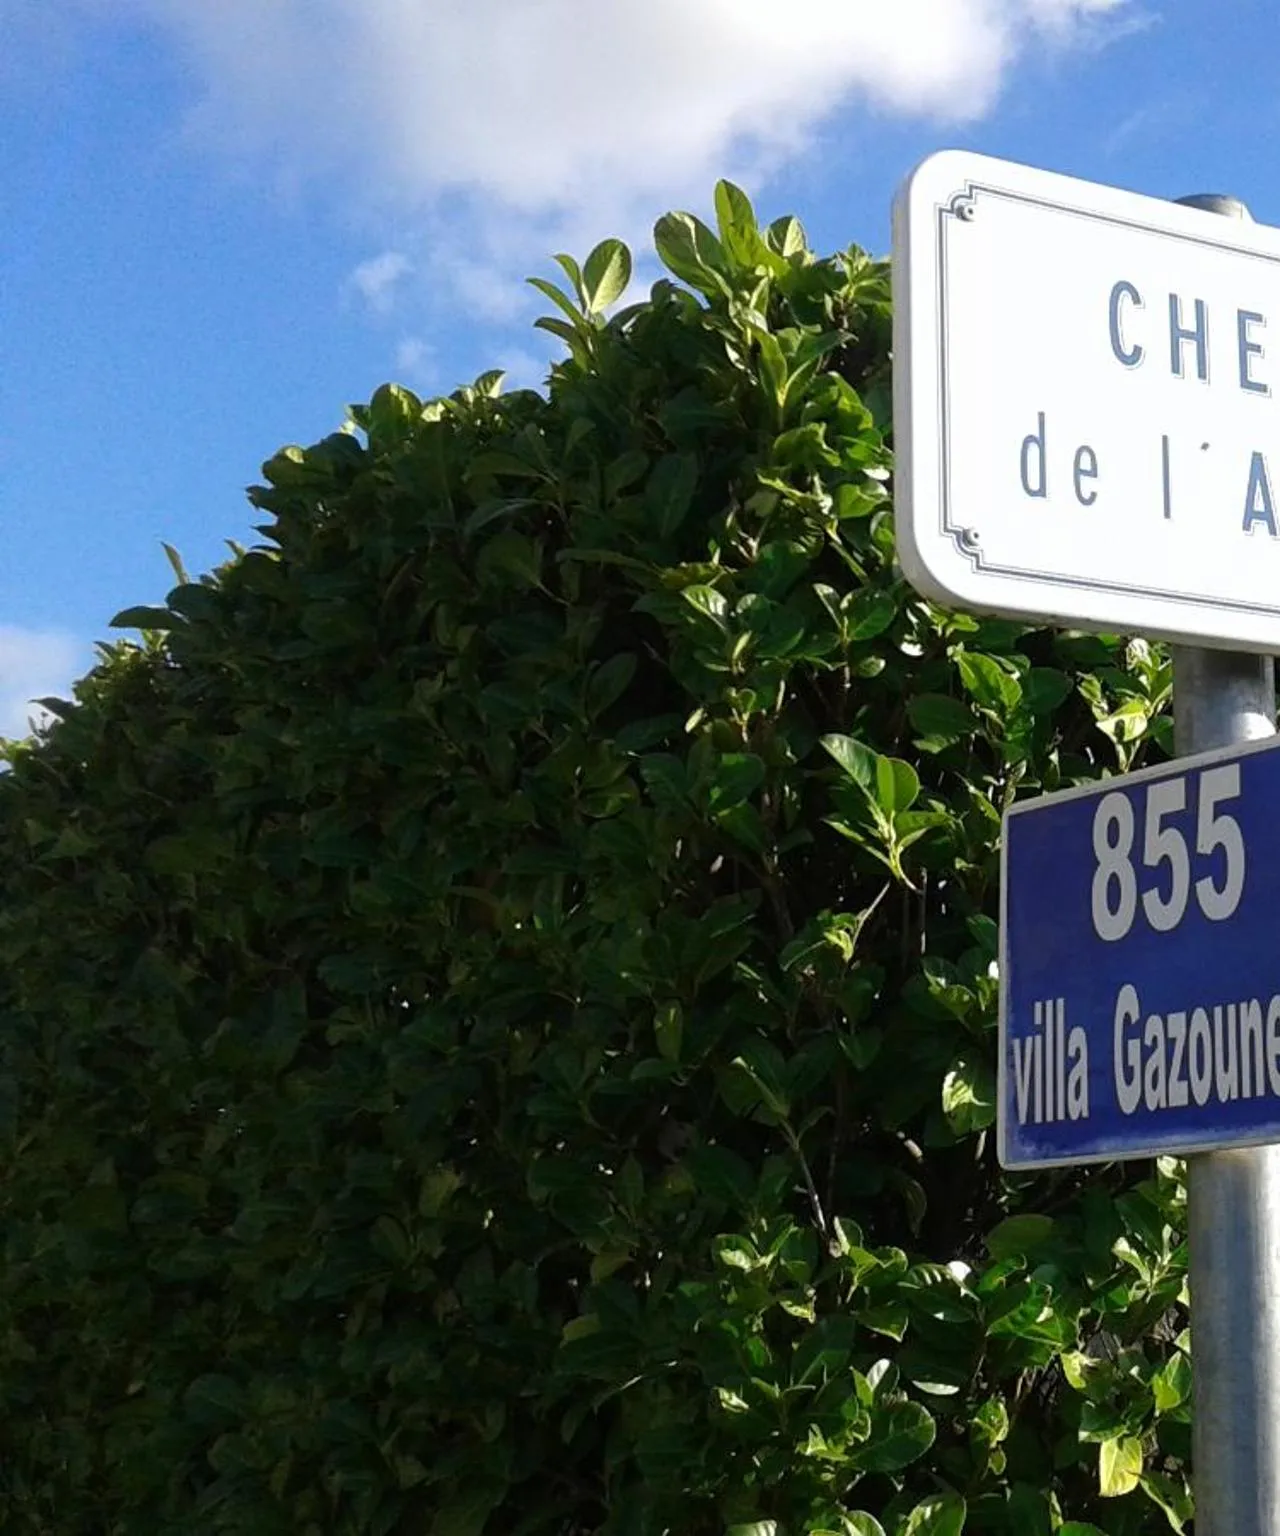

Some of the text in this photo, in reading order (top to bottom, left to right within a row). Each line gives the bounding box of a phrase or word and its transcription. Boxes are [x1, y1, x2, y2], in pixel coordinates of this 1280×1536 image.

[1019, 411, 1100, 507] de
[1091, 763, 1246, 942] 855
[1012, 998, 1090, 1126] villa
